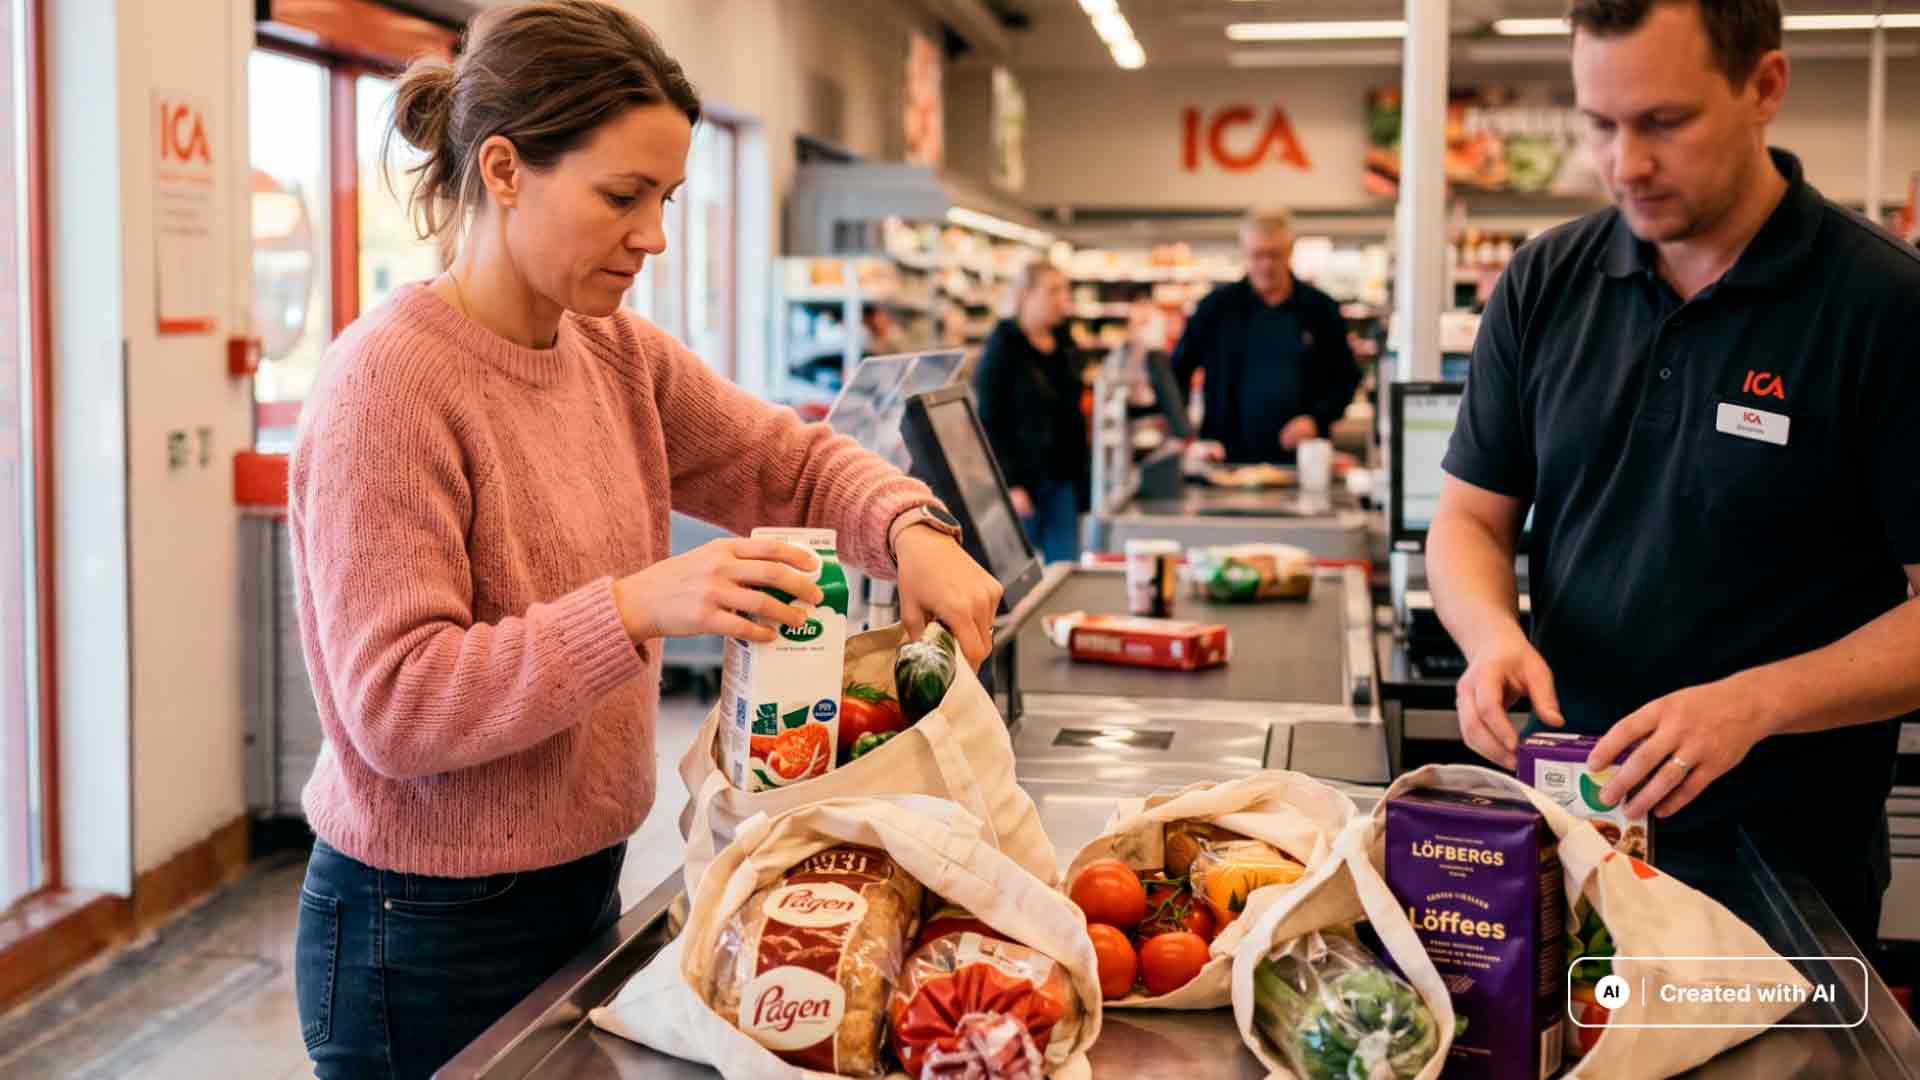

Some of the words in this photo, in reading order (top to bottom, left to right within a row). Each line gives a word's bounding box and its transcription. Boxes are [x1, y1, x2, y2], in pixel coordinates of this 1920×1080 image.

[160, 102, 211, 164] ICA
[1181, 105, 1311, 173] ICA
[1742, 369, 1785, 399] ICA
[1743, 411, 1762, 425] ICA
[784, 623, 817, 636] Arla
[1412, 840, 1504, 866] LÖFBERGS
[1409, 907, 1506, 939] Löffees
